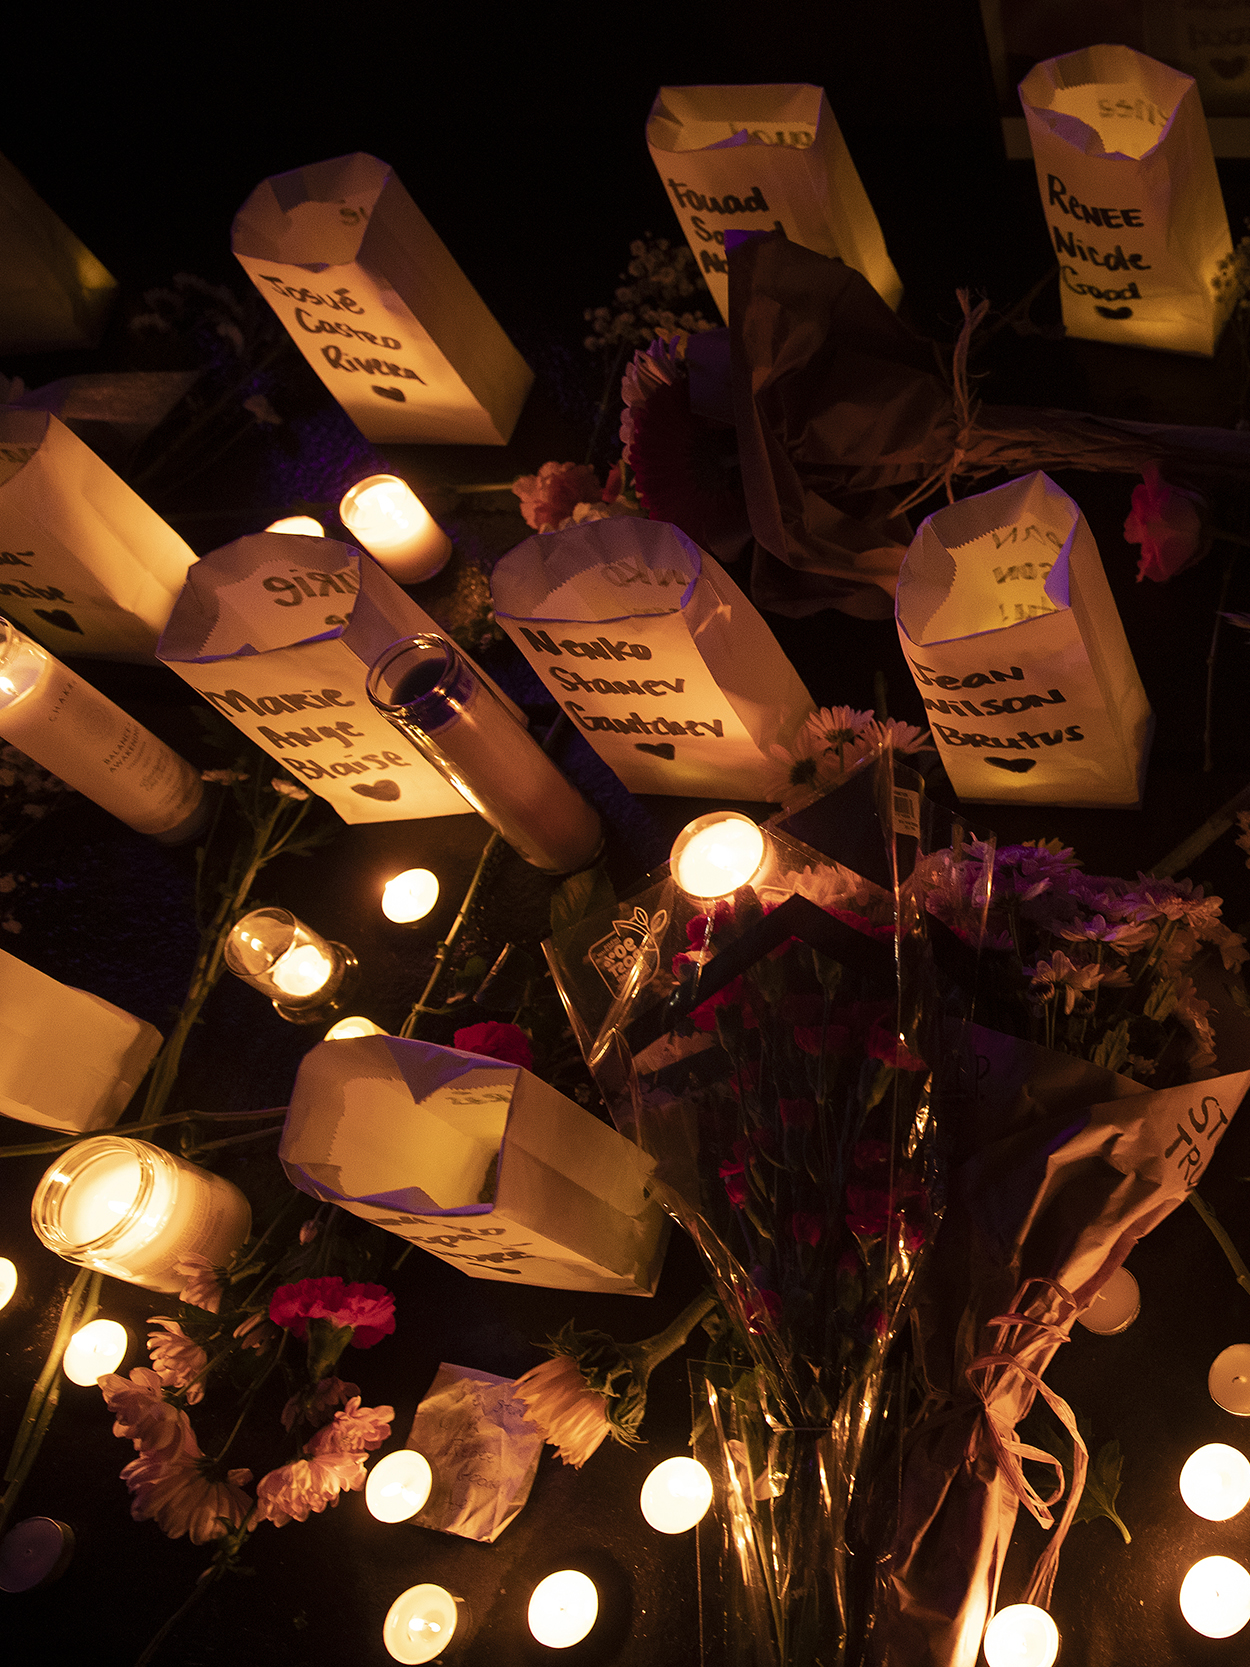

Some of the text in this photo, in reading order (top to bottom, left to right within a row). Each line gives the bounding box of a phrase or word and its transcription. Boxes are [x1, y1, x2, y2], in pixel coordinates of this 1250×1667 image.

[668, 178, 769, 214] Fouad
[1053, 226, 1151, 271] Nicole
[1061, 265, 1143, 301] Good
[549, 666, 685, 697] Stanev
[282, 750, 411, 781] Blaise
